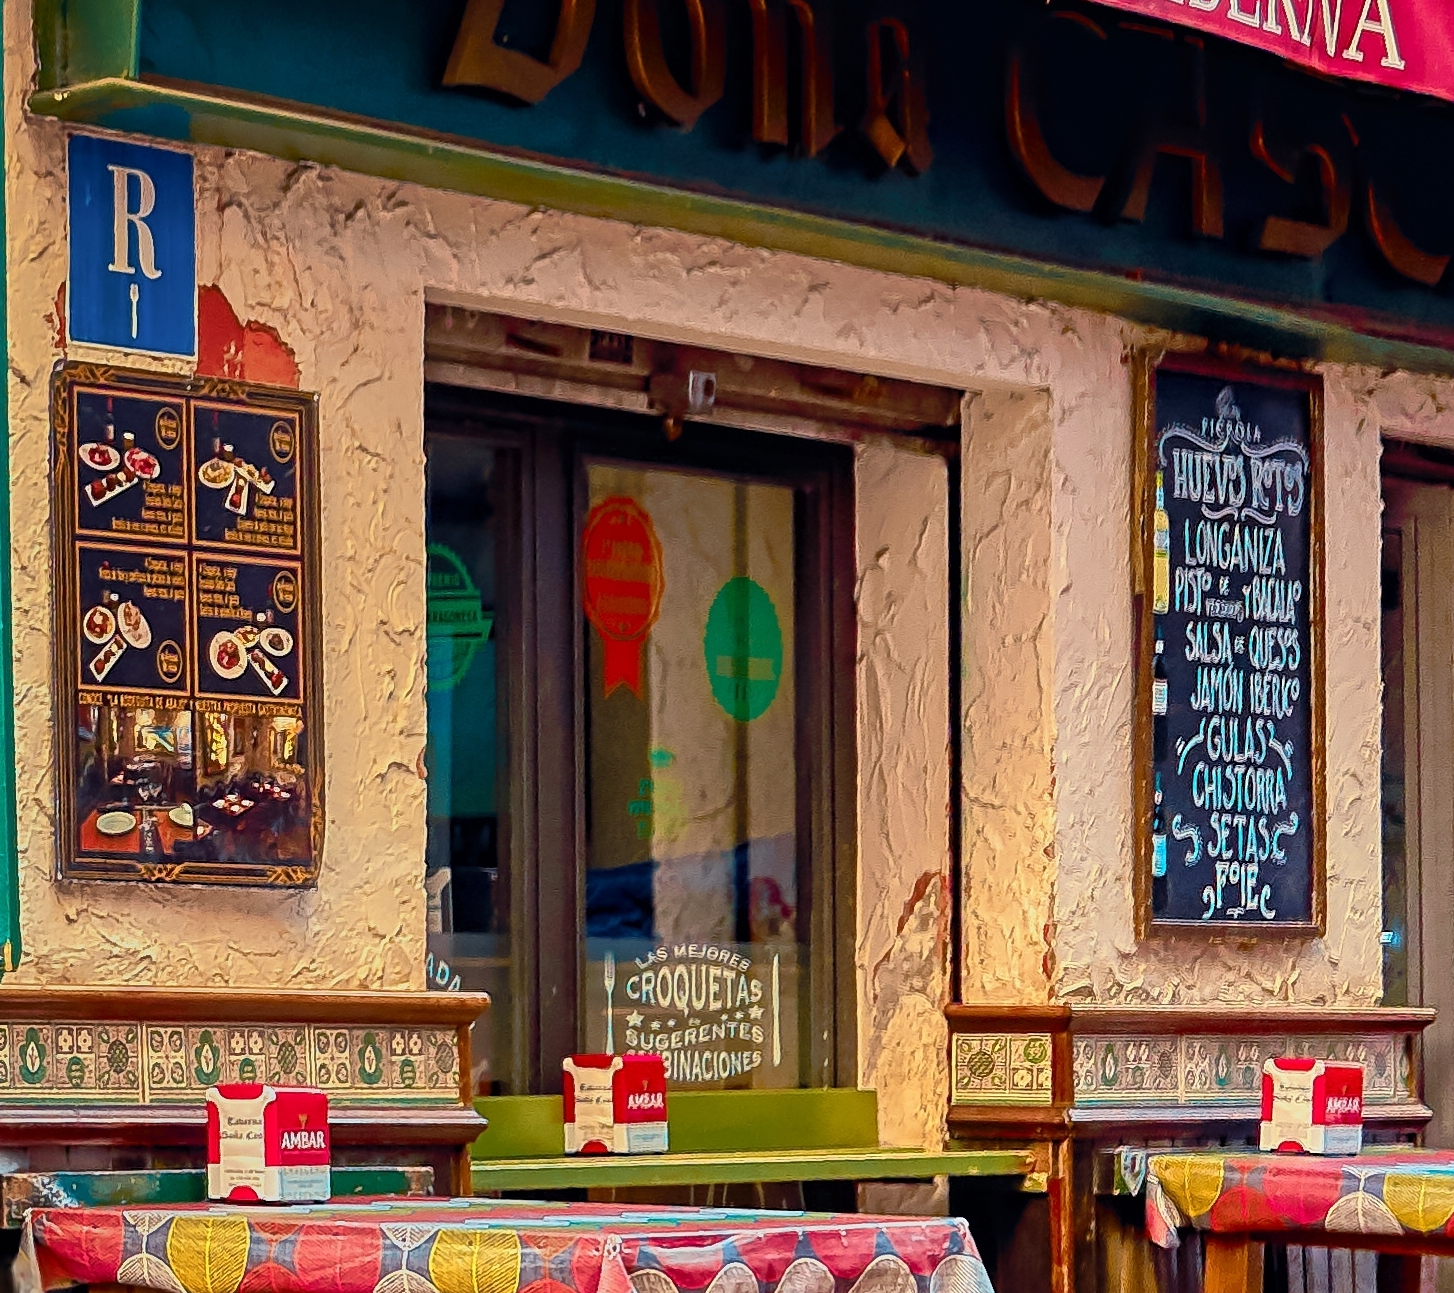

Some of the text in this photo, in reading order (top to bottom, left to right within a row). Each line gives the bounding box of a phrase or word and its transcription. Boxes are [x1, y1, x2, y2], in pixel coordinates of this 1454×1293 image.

[107, 164, 162, 280] R
[1184, 518, 1286, 576] LONGANIZA
[1175, 566, 1212, 616] PISTO
[1185, 621, 1232, 664] SALSA
[1191, 661, 1244, 715] JAMÓN
[1207, 715, 1267, 763] GULAS
[1193, 760, 1287, 814] CHISTORRA
[1208, 811, 1271, 861] SETAS
[1215, 861, 1258, 910] FOIE
[634, 943, 752, 973] LAS MEJORES
[626, 963, 763, 1018] CROQUETAS
[625, 1021, 764, 1051] SUGERENTES
[627, 1049, 762, 1082] BINACIONES
[281, 1131, 326, 1149] AMBAR
